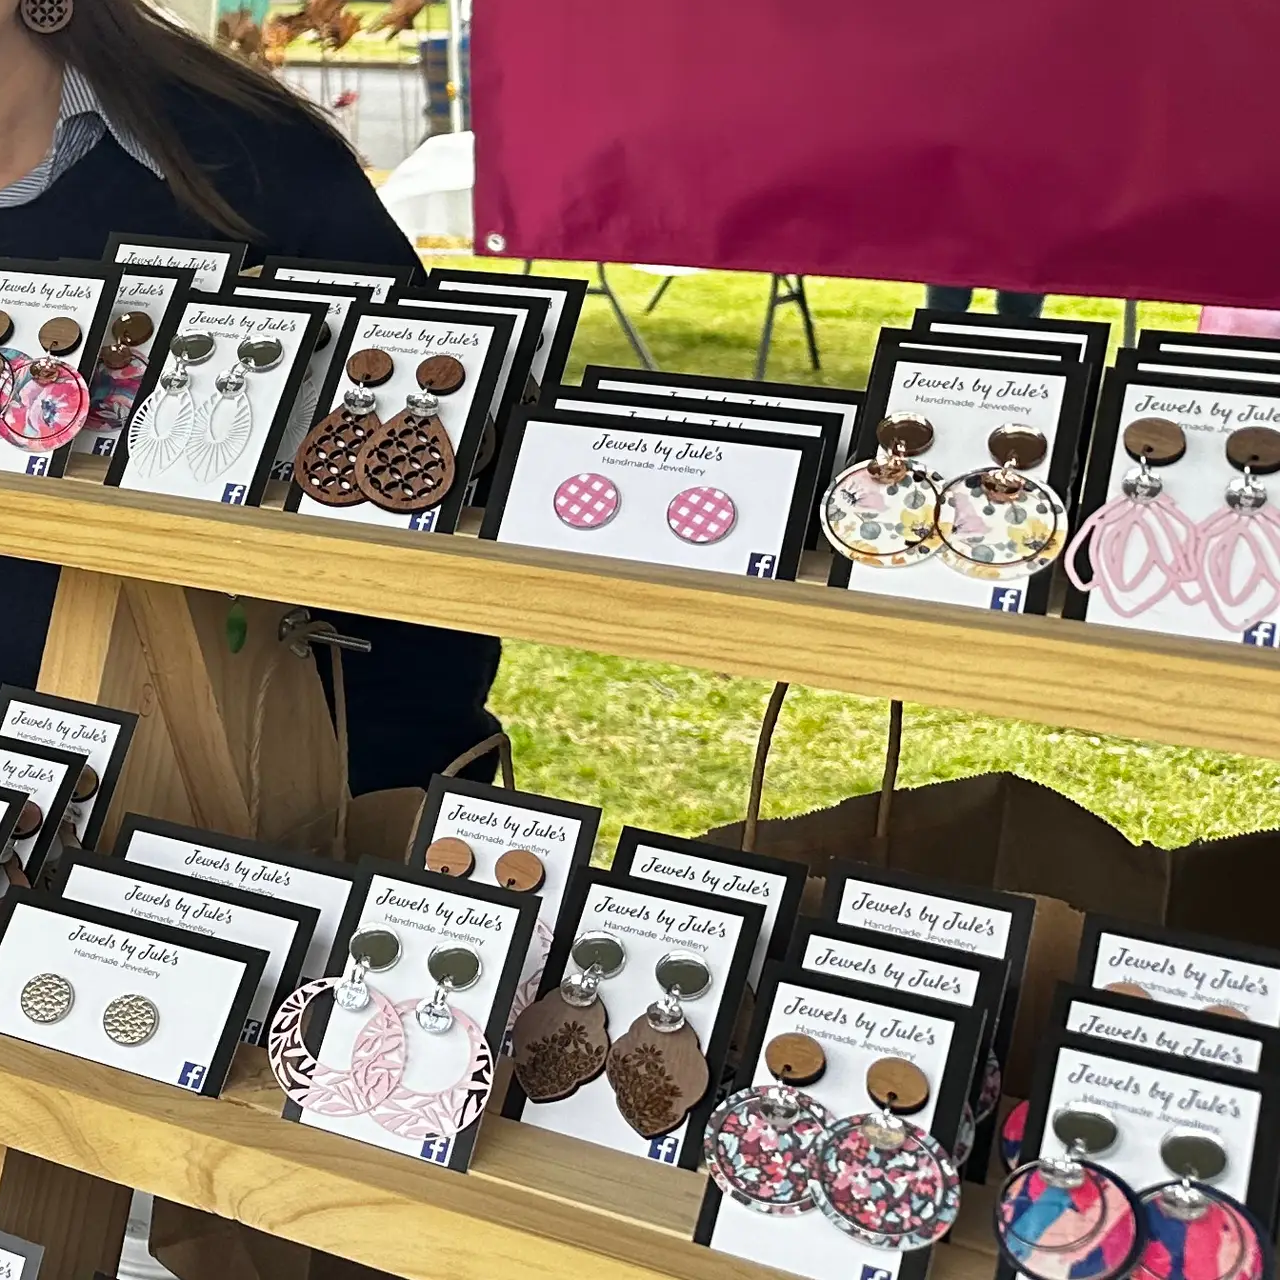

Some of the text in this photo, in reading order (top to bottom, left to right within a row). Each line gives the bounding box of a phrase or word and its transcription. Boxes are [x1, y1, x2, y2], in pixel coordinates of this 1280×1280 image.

[40, 283, 54, 300] by
[56, 285, 91, 299] Jule's
[129, 283, 164, 295] Jule's
[189, 311, 296, 331] Jewels by Jule's
[364, 324, 478, 347] Jewels by Jule's
[903, 372, 1048, 400] Jewels by Jule's
[915, 395, 1032, 414] Handmade Jewellery
[1135, 395, 1280, 423] Jewels by Jule
[593, 434, 723, 462] Jewels by Jule's
[602, 456, 705, 476] Handmade Jewellery
[11, 711, 108, 743] Jewels by Jule's
[3, 760, 16, 779] by
[18, 764, 54, 782] Jule's
[448, 804, 566, 842] Jewels by Jule's
[456, 828, 504, 845] Handmade
[185, 849, 291, 886] Jewels by Jule's
[641, 857, 769, 897] Jewels by Jule's
[125, 885, 232, 924] Jewels by Jule's
[376, 888, 502, 932] Jewels by Jule's
[594, 896, 726, 938] Jewels by Jule's
[851, 892, 995, 936] Jewels by Jule's
[68, 925, 179, 966] Jewels by Jule's
[385, 913, 485, 946] Handmade Jewellery
[604, 920, 709, 952] Handmade Jewellery
[74, 948, 160, 979] Handmade Jewellery
[815, 948, 961, 994] Jewels by Jule's
[1108, 947, 1268, 996] Jewels by Jule's
[783, 997, 935, 1045] Jewels by Jule's
[1079, 1015, 1243, 1064] Jewels by Jule's
[1068, 1063, 1240, 1118] Jewels by Jule's
